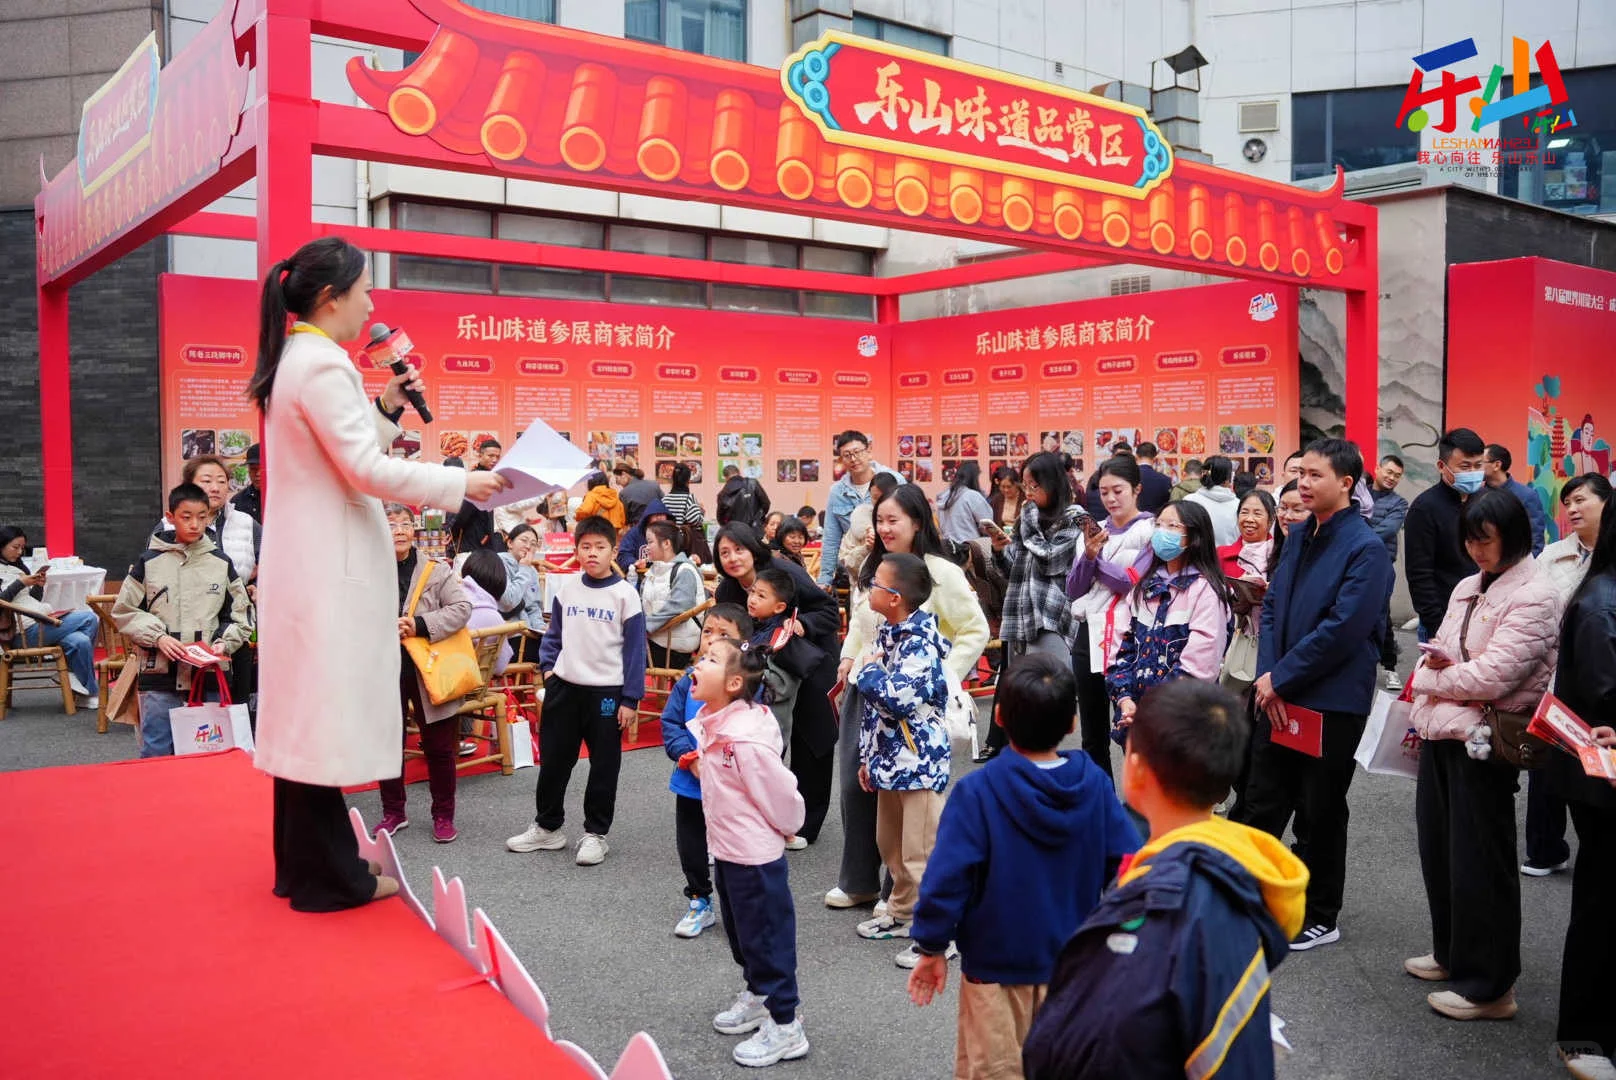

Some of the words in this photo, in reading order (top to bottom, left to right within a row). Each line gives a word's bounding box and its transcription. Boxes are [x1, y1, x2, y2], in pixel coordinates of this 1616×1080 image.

[854, 61, 1133, 167] 乐山味道品赏区
[456, 314, 676, 351] 乐山味道参展商家简介
[976, 314, 1155, 355] 乐山味道参展商家简介
[566, 606, 615, 621] IN-WIN
